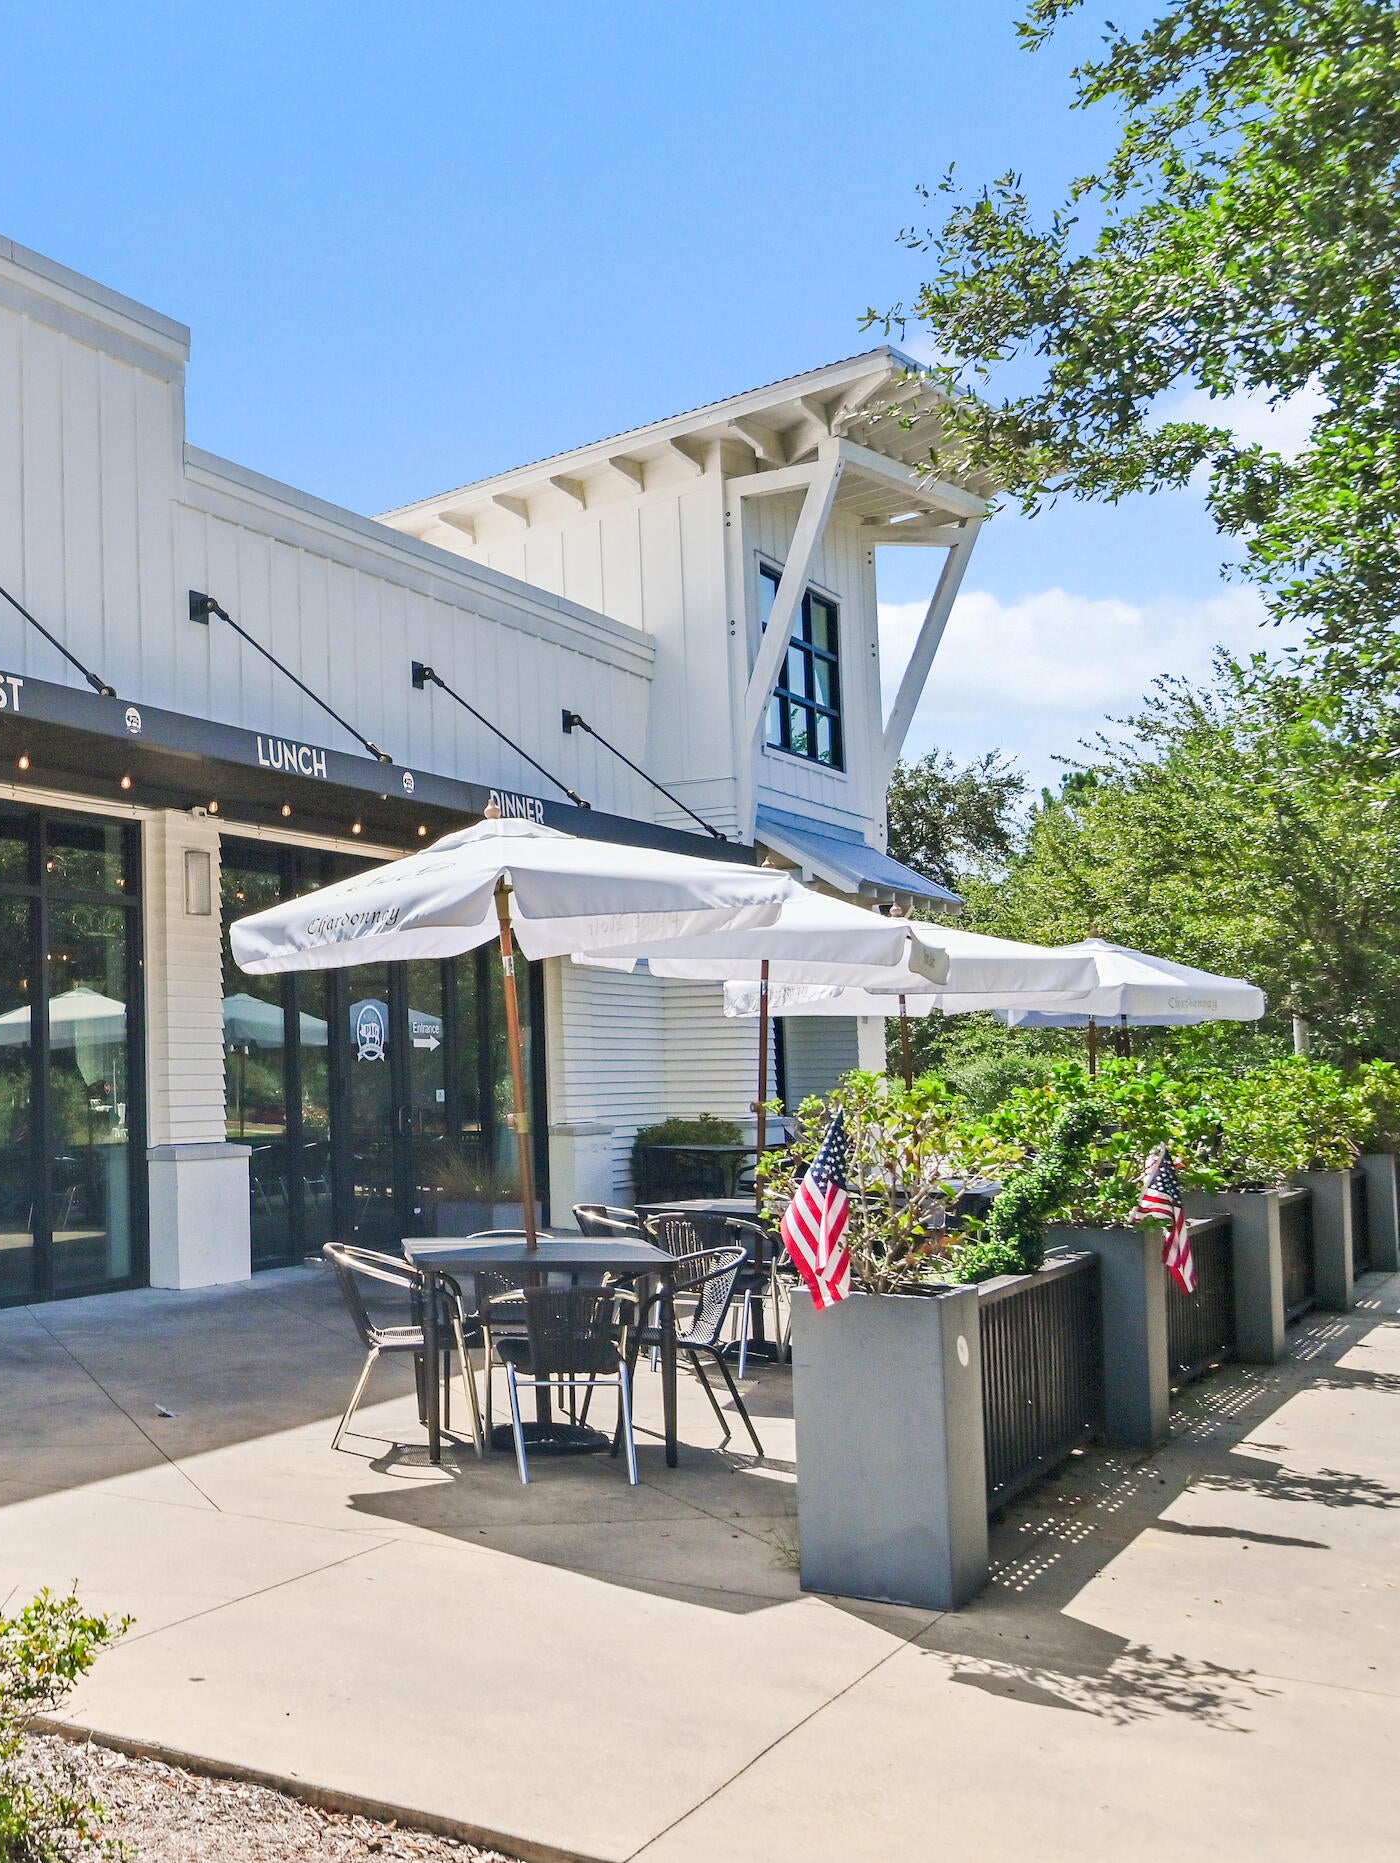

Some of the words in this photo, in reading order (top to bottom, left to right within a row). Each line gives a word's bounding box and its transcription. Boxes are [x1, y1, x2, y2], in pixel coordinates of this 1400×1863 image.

[257, 736, 327, 779] LUNCH
[490, 790, 545, 824] DINNER
[365, 1025, 379, 1036] PIG
[412, 1021, 440, 1034] Entrance
